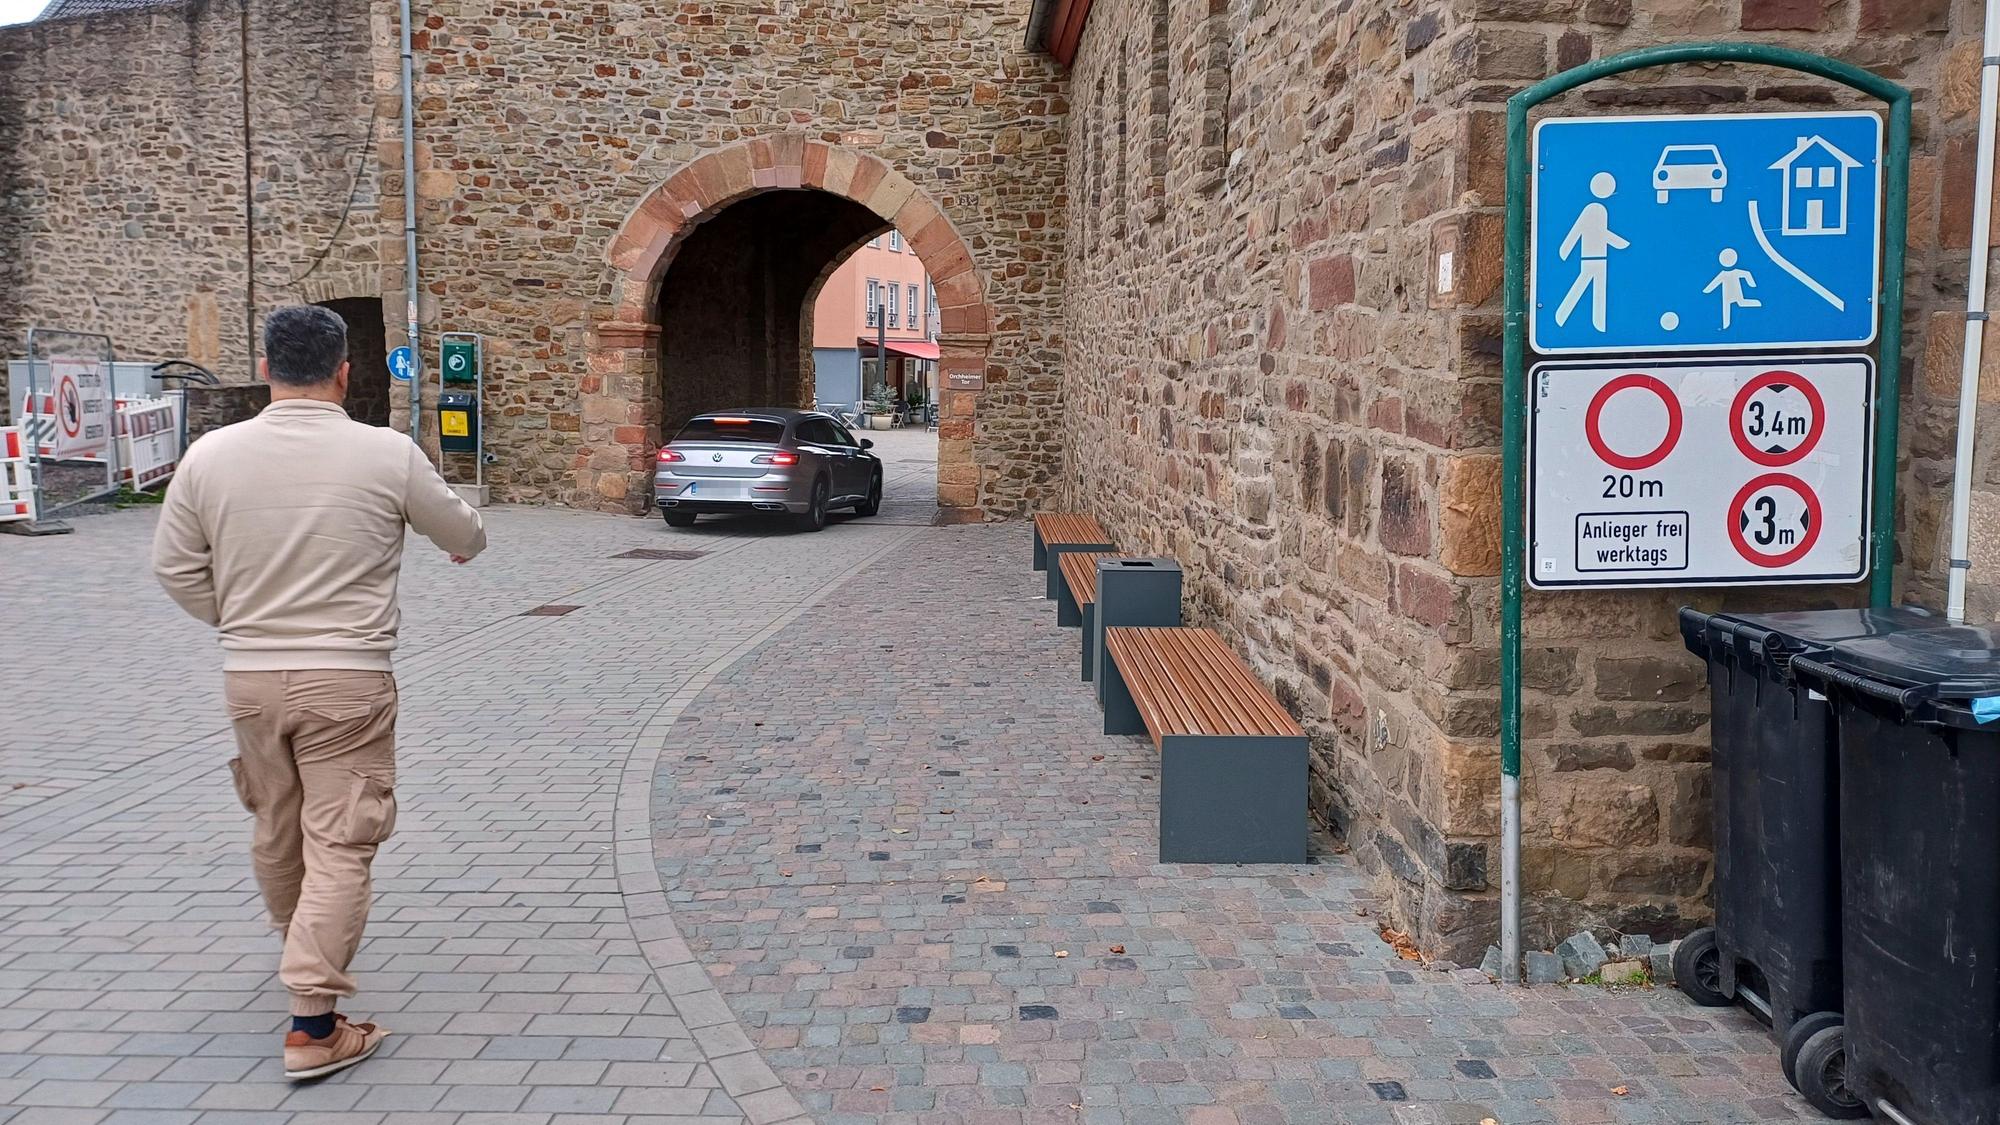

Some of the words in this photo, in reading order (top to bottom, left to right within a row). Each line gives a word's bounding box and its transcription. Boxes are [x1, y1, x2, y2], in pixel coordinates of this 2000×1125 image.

[1583, 521, 1648, 542] Anlieger
[1656, 519, 1682, 537] frei
[1597, 545, 1668, 566] werktags
